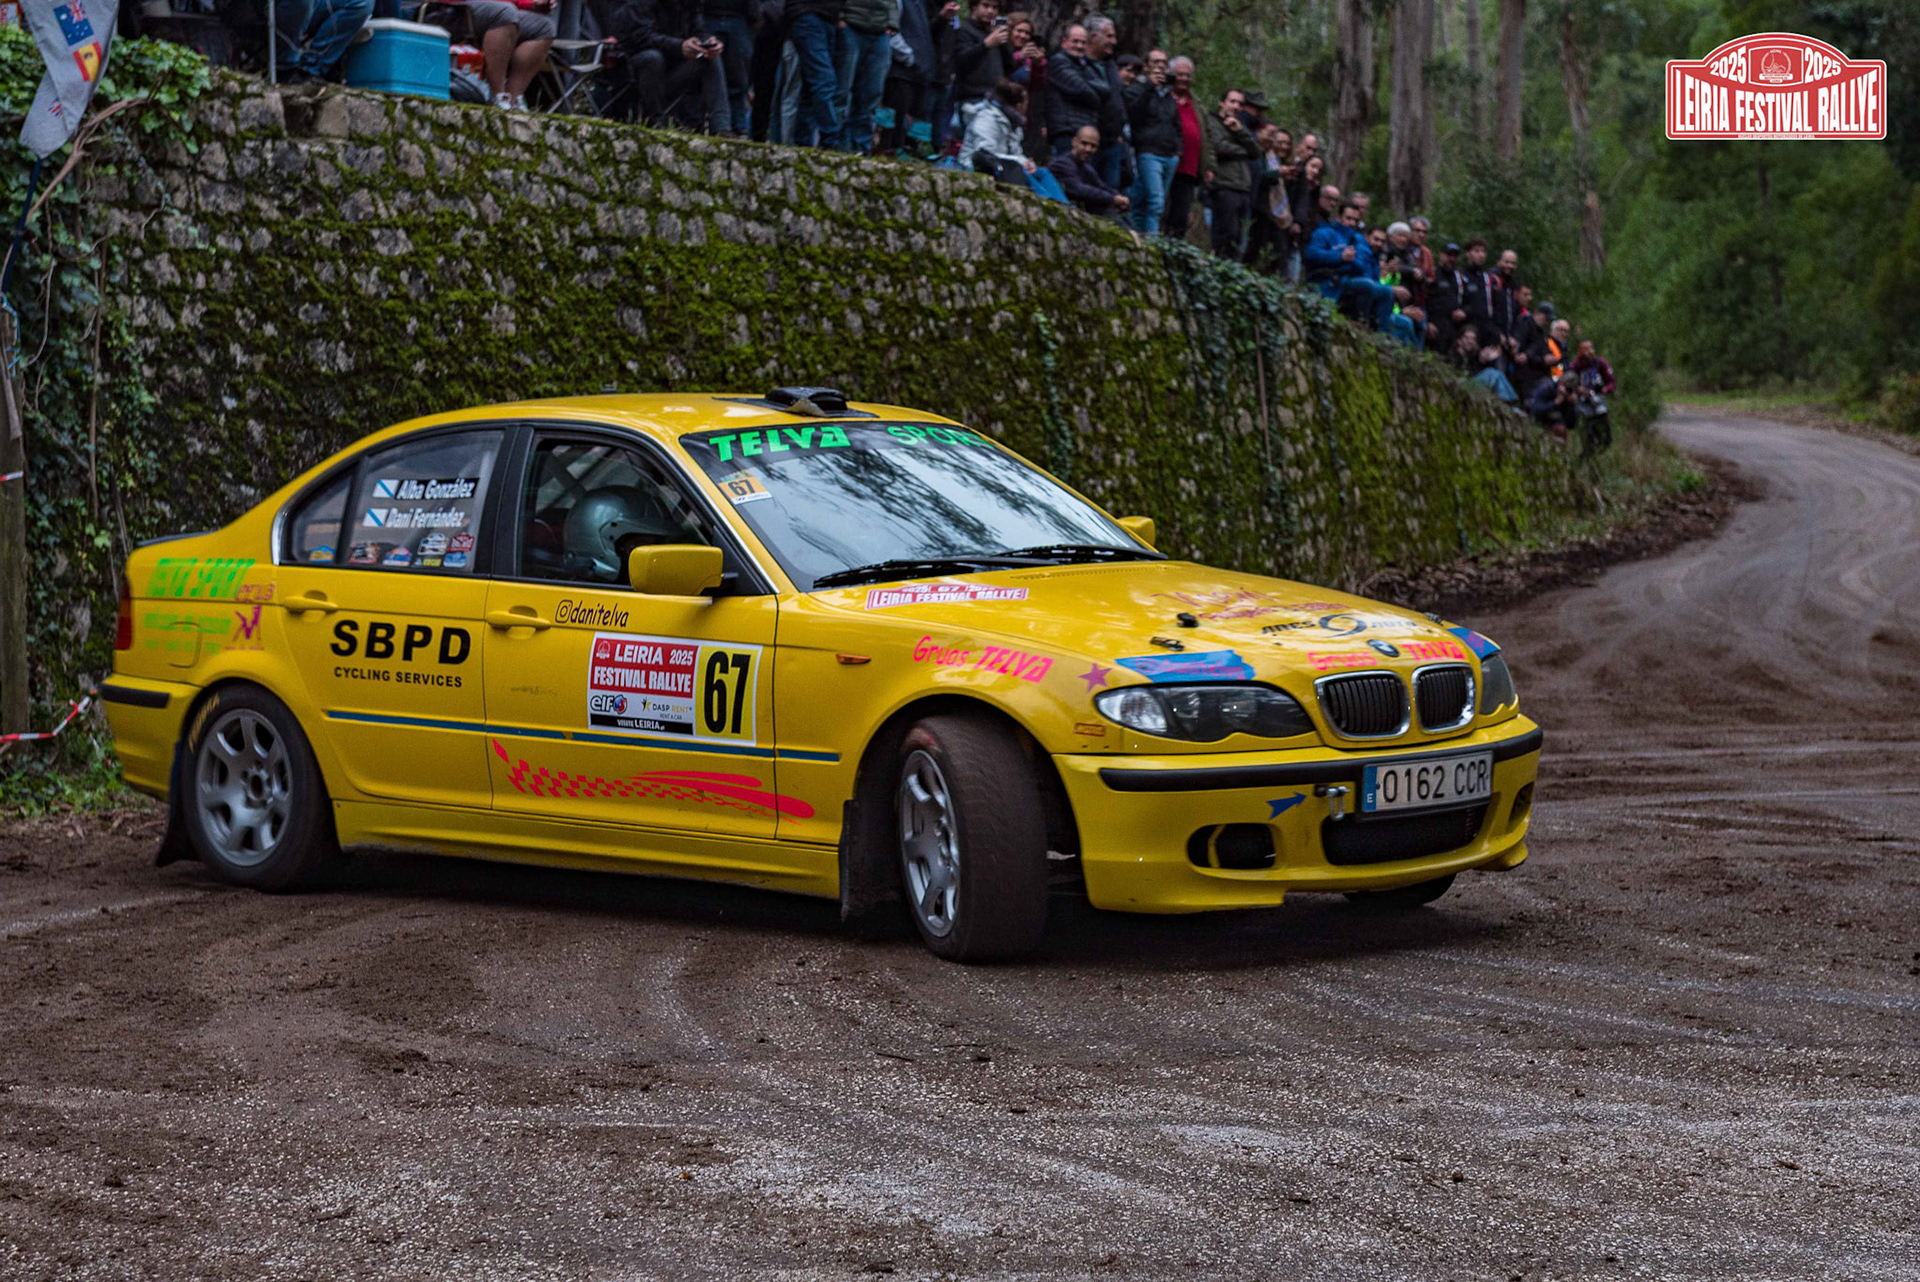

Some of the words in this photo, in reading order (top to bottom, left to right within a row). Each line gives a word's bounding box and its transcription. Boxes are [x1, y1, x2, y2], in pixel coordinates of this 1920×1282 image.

[709, 426, 851, 463] TELVA
[396, 479, 425, 500] Alba
[424, 477, 476, 500] González
[728, 478, 756, 496] 67
[385, 507, 414, 528] Dani
[873, 590, 913, 608] LEIRIA
[916, 590, 971, 603] FESTIVAL
[976, 588, 1021, 600] RALLYE
[1261, 620, 1315, 635] ARES
[330, 619, 472, 665] SBPD
[1402, 641, 1465, 662] TELVA
[614, 643, 664, 666] LEIRIA
[669, 649, 694, 666] 2025
[913, 635, 970, 668] Gruas
[973, 645, 1055, 683] TELVA
[334, 666, 391, 682] CYCLING
[396, 671, 463, 688] SERVICES
[593, 665, 647, 689] FESTIVAL
[648, 670, 692, 693] RALLYE
[704, 650, 752, 734] 67
[590, 694, 615, 713] elf
[652, 703, 671, 712] DASP
[1382, 765, 1446, 804] 0162
[1453, 759, 1487, 796] CCR
[1366, 793, 1373, 803] E
